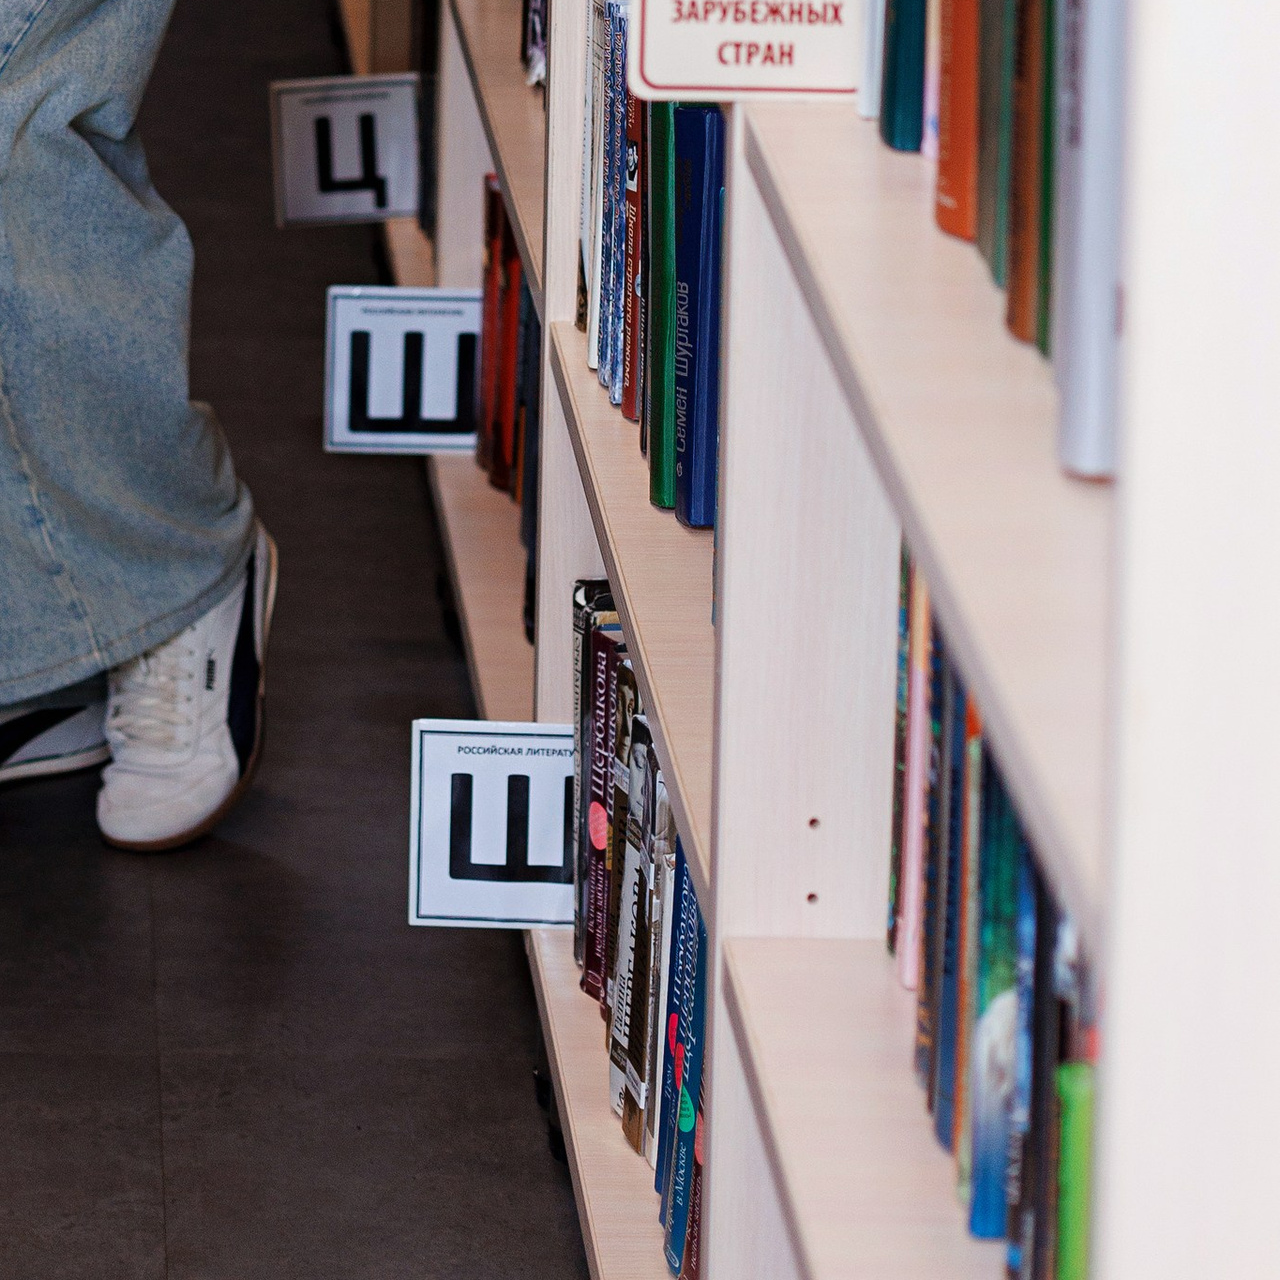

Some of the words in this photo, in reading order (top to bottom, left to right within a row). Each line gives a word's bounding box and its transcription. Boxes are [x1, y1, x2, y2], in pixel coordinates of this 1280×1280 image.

[717, 40, 794, 66] СТРАН
[314, 114, 387, 208] Ц
[627, 203, 637, 255] Школа
[624, 326, 632, 388] режима
[675, 281, 693, 378] Шуртаков
[676, 386, 688, 454] Семен
[457, 745, 523, 757] РОССИЙСКАЯ
[590, 651, 610, 799] Щербакова
[676, 1140, 686, 1196] Москве
